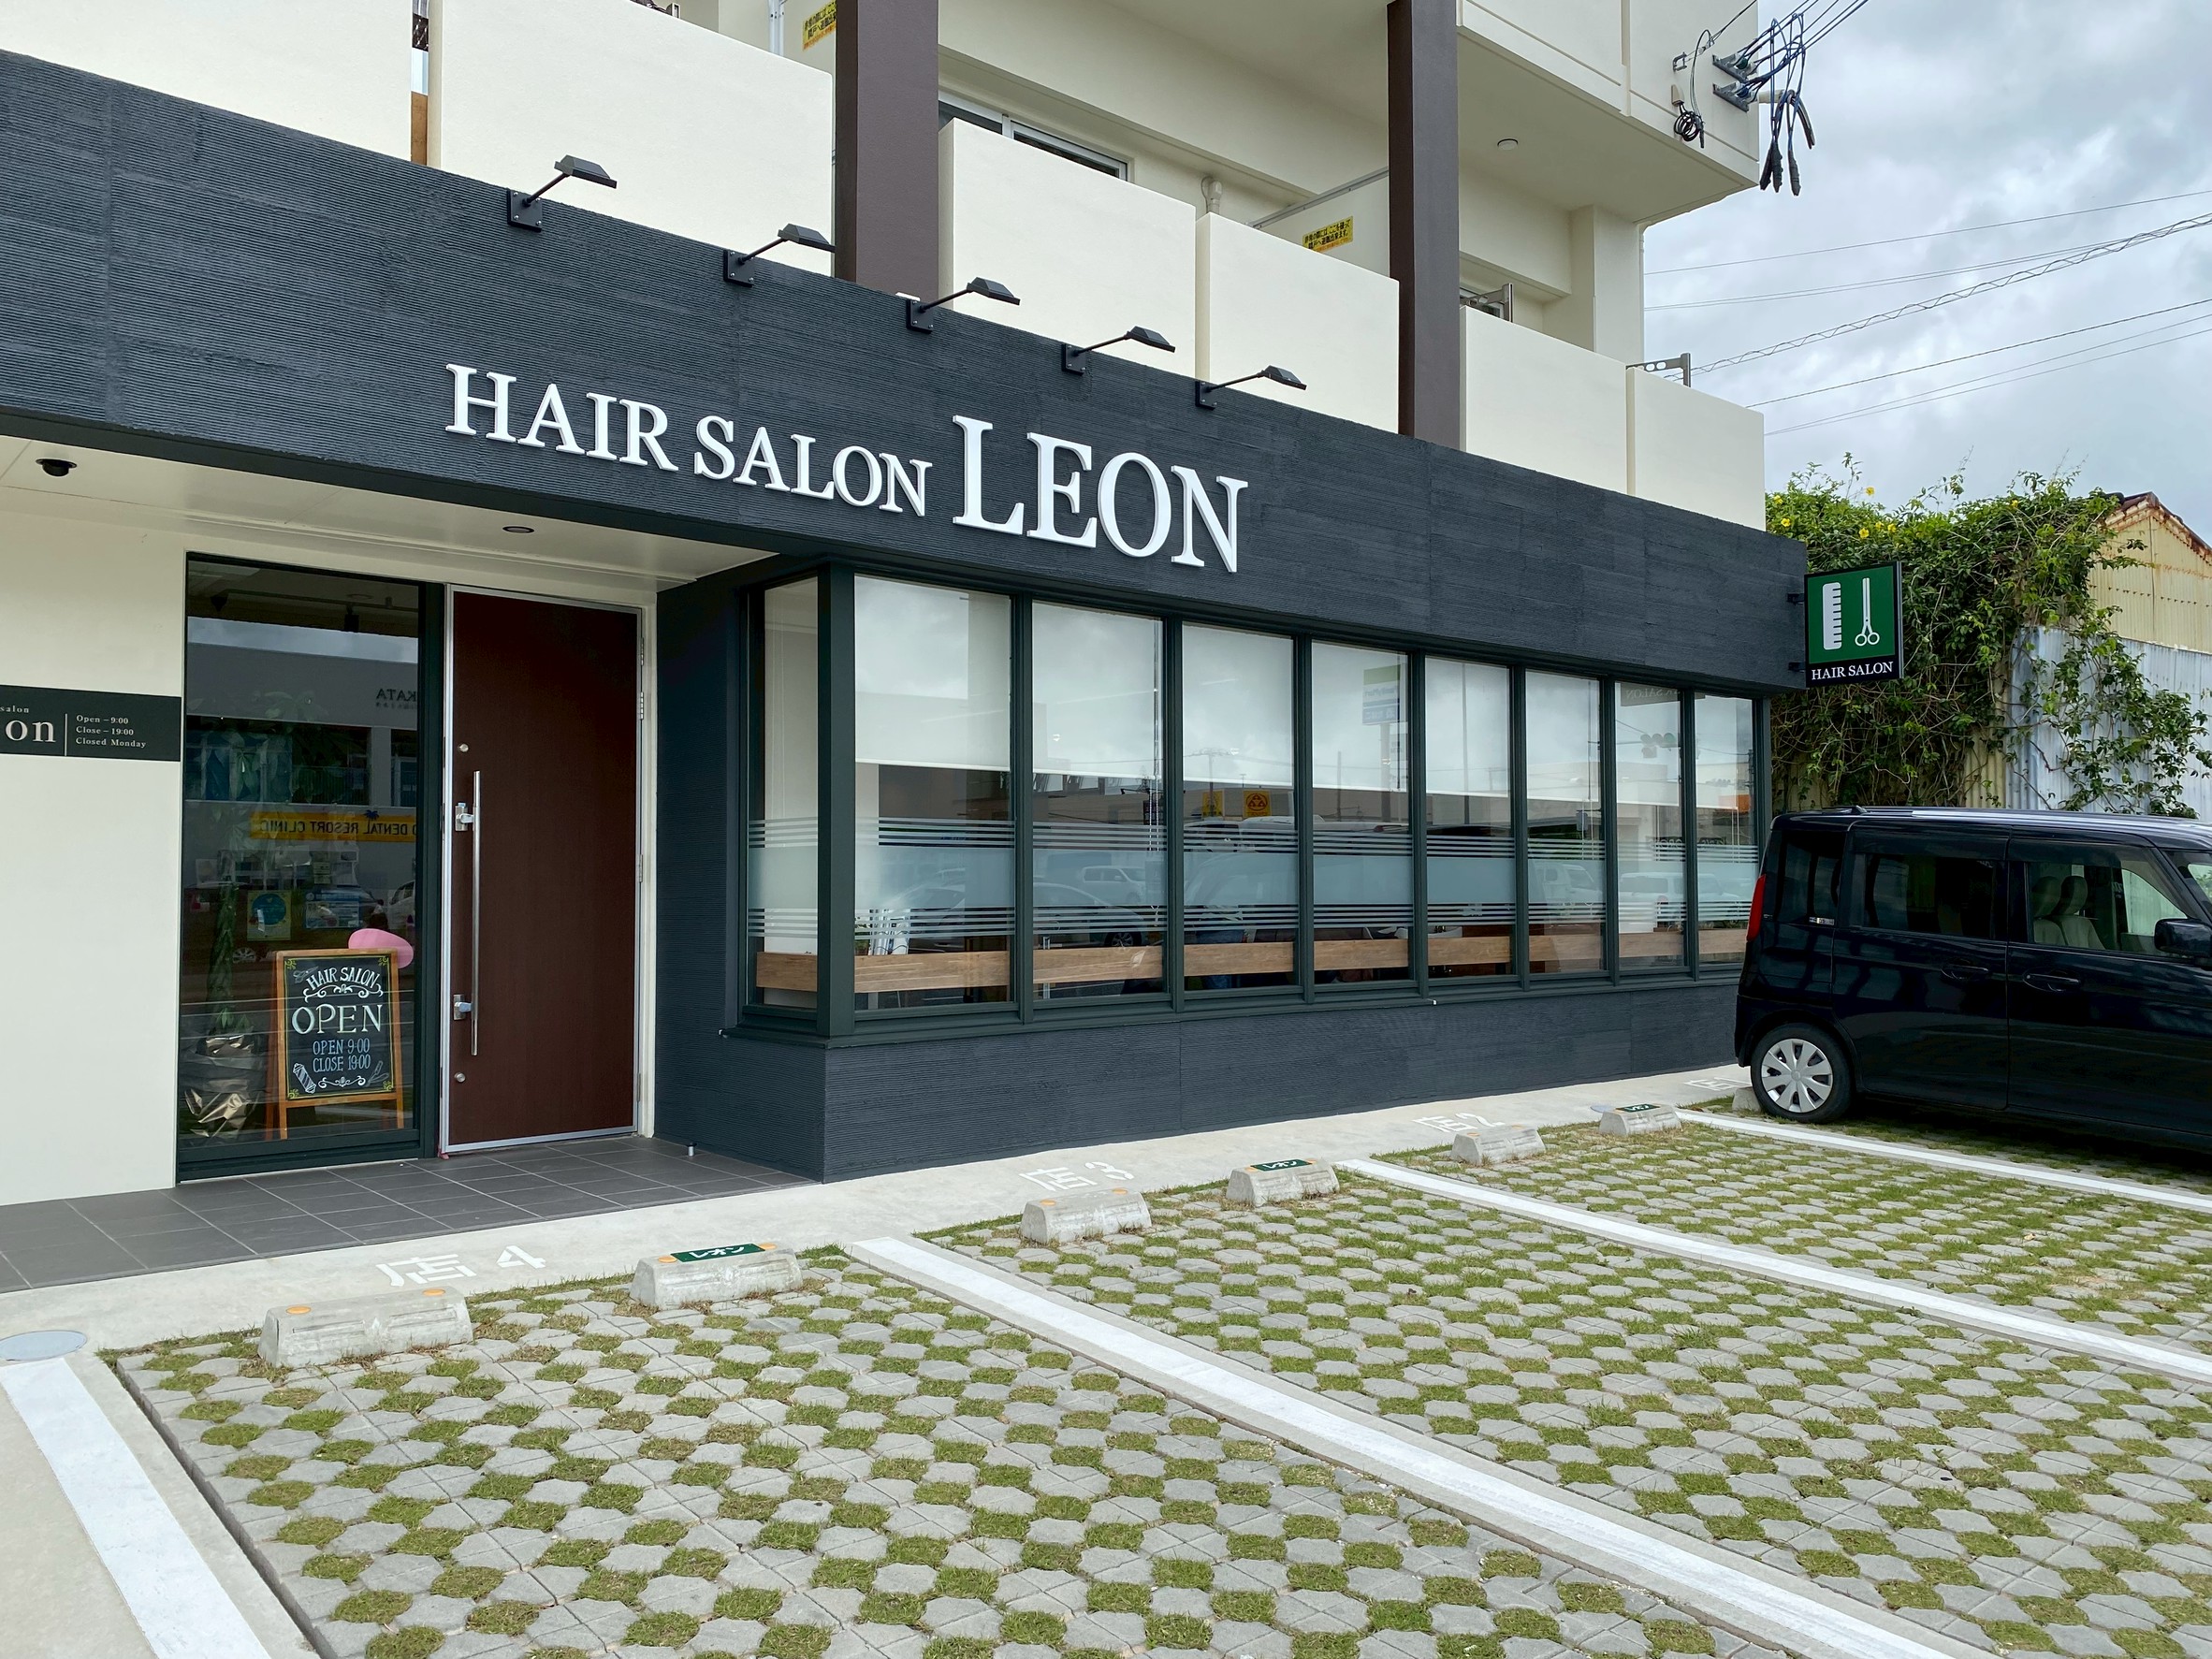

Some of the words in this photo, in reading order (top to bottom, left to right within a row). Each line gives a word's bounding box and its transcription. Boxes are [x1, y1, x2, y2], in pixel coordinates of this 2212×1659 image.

[445, 363, 679, 472] HAIR
[693, 415, 933, 517] SALON
[952, 415, 1248, 573] LEON
[1812, 666, 1846, 680] HAIR
[1848, 661, 1894, 677] SALON
[0, 705, 29, 713] salon
[76, 714, 100, 723] Open
[5, 720, 56, 743] on
[76, 725, 101, 735] Close
[76, 736, 107, 746] Closed
[110, 738, 147, 749] Monday
[306, 968, 339, 990] HAIR
[340, 967, 380, 989] SALON
[291, 1004, 383, 1034] OPEN
[313, 1039, 344, 1055] OPEN
[347, 1038, 371, 1054] 9:00
[313, 1055, 344, 1072] CLOSE
[347, 1055, 371, 1070] 19:00
[689, 1246, 745, 1259] レオン
